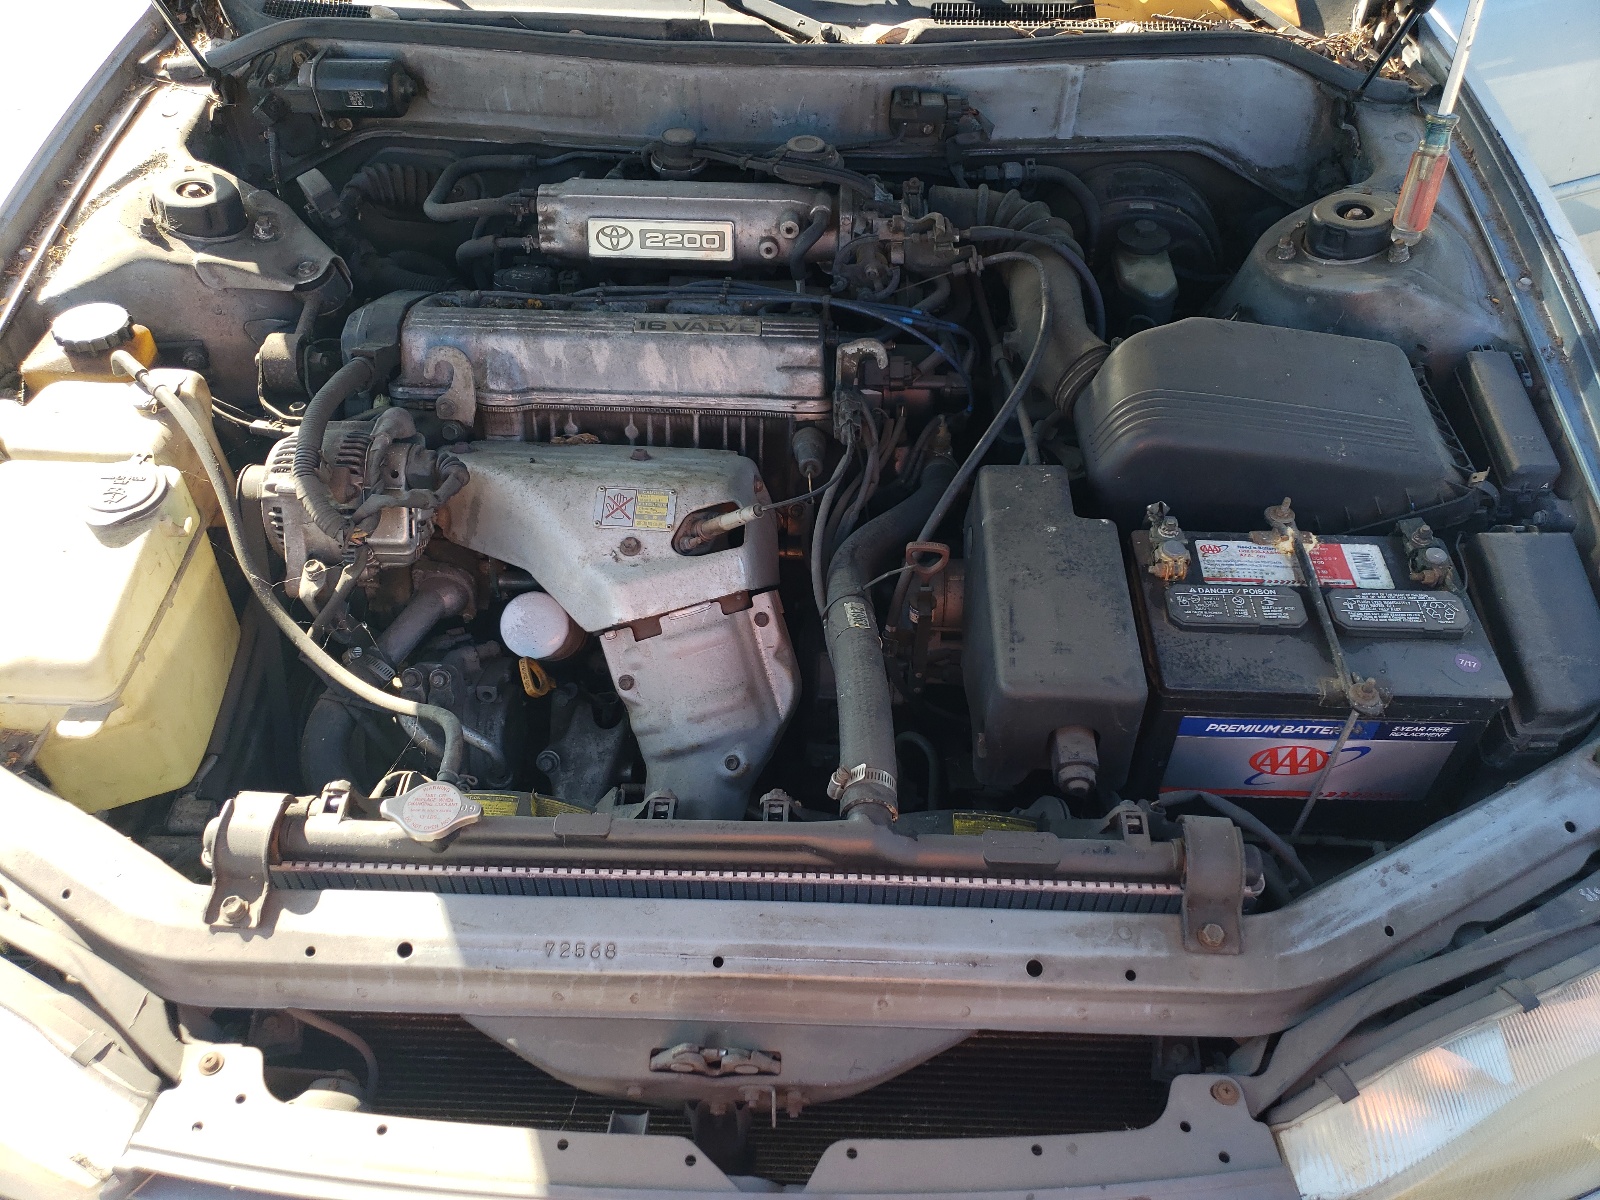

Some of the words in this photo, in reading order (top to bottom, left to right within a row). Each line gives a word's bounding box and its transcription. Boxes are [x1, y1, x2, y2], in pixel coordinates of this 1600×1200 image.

[645, 232, 721, 249] 2200
[638, 320, 667, 331] 16
[672, 320, 758, 333] VALVE
[1200, 545, 1222, 554] AAA
[1197, 587, 1235, 595] DANGER
[1458, 658, 1477, 668] 7/17
[1205, 723, 1279, 734] PREMIUM
[1281, 725, 1341, 735] BATTER
[1257, 746, 1325, 774] AAA
[423, 785, 451, 793] WARNING
[411, 822, 422, 830] NOT
[440, 817, 452, 826] HOT
[545, 942, 617, 960] 72568
